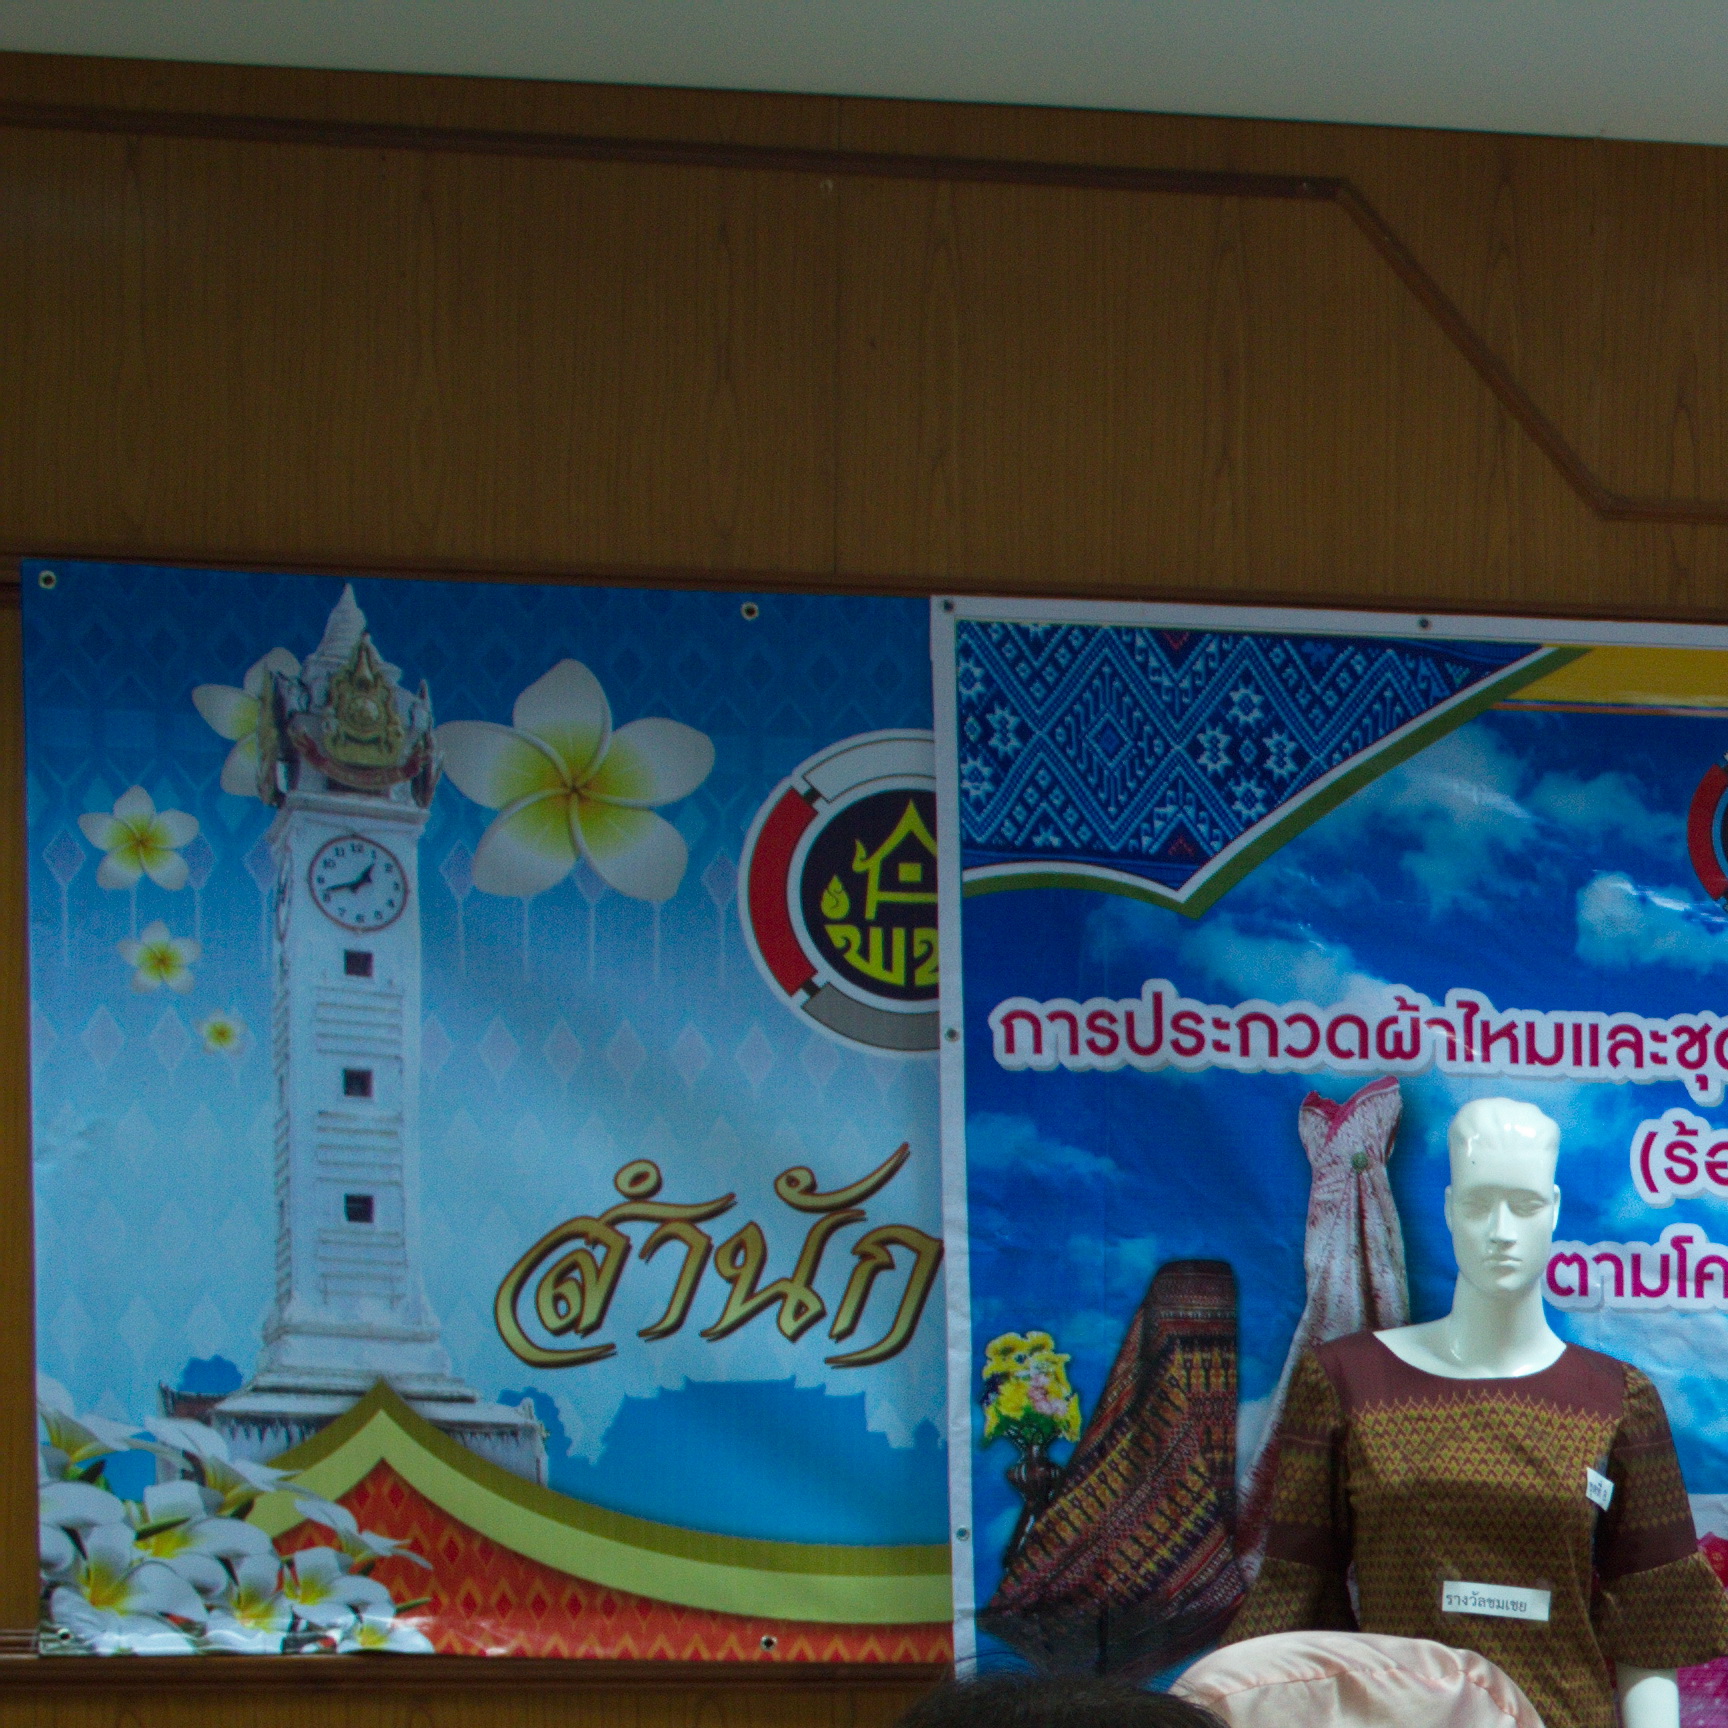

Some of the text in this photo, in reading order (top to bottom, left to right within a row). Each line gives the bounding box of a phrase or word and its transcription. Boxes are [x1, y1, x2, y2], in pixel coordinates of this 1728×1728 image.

[1445, 1590, 1528, 1614] รางวัลชมเชย
